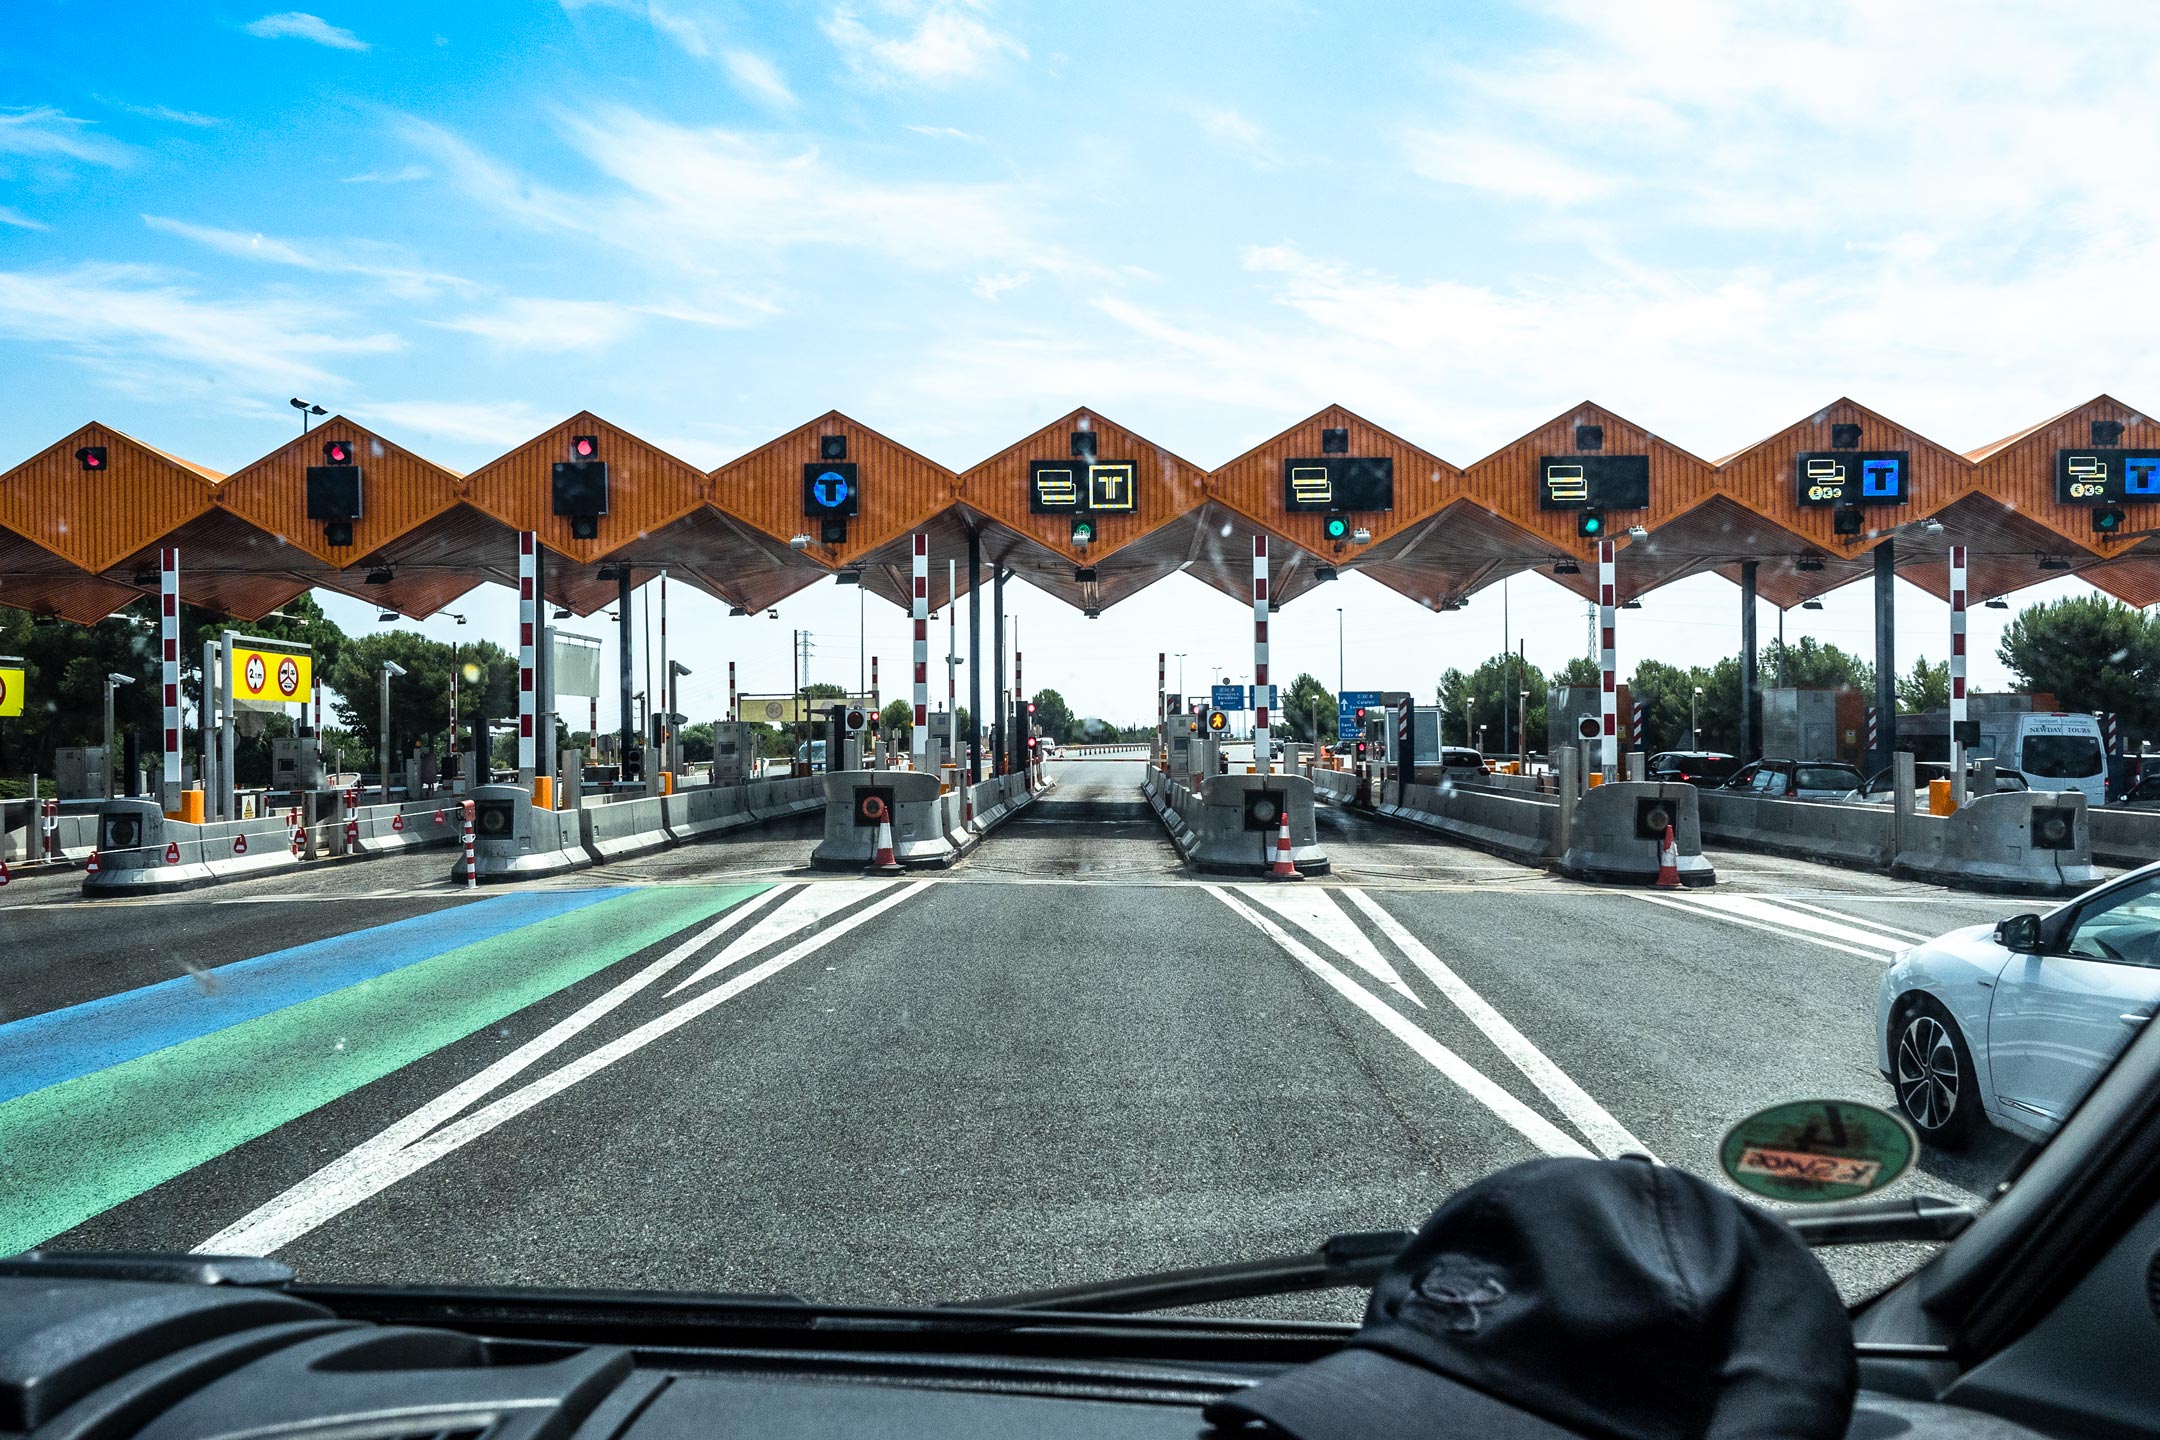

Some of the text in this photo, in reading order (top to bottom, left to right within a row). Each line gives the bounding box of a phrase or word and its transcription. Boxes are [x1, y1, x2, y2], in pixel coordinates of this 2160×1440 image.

[817, 479, 844, 501] T
[1098, 477, 1122, 499] T
[1867, 468, 1894, 490] T
